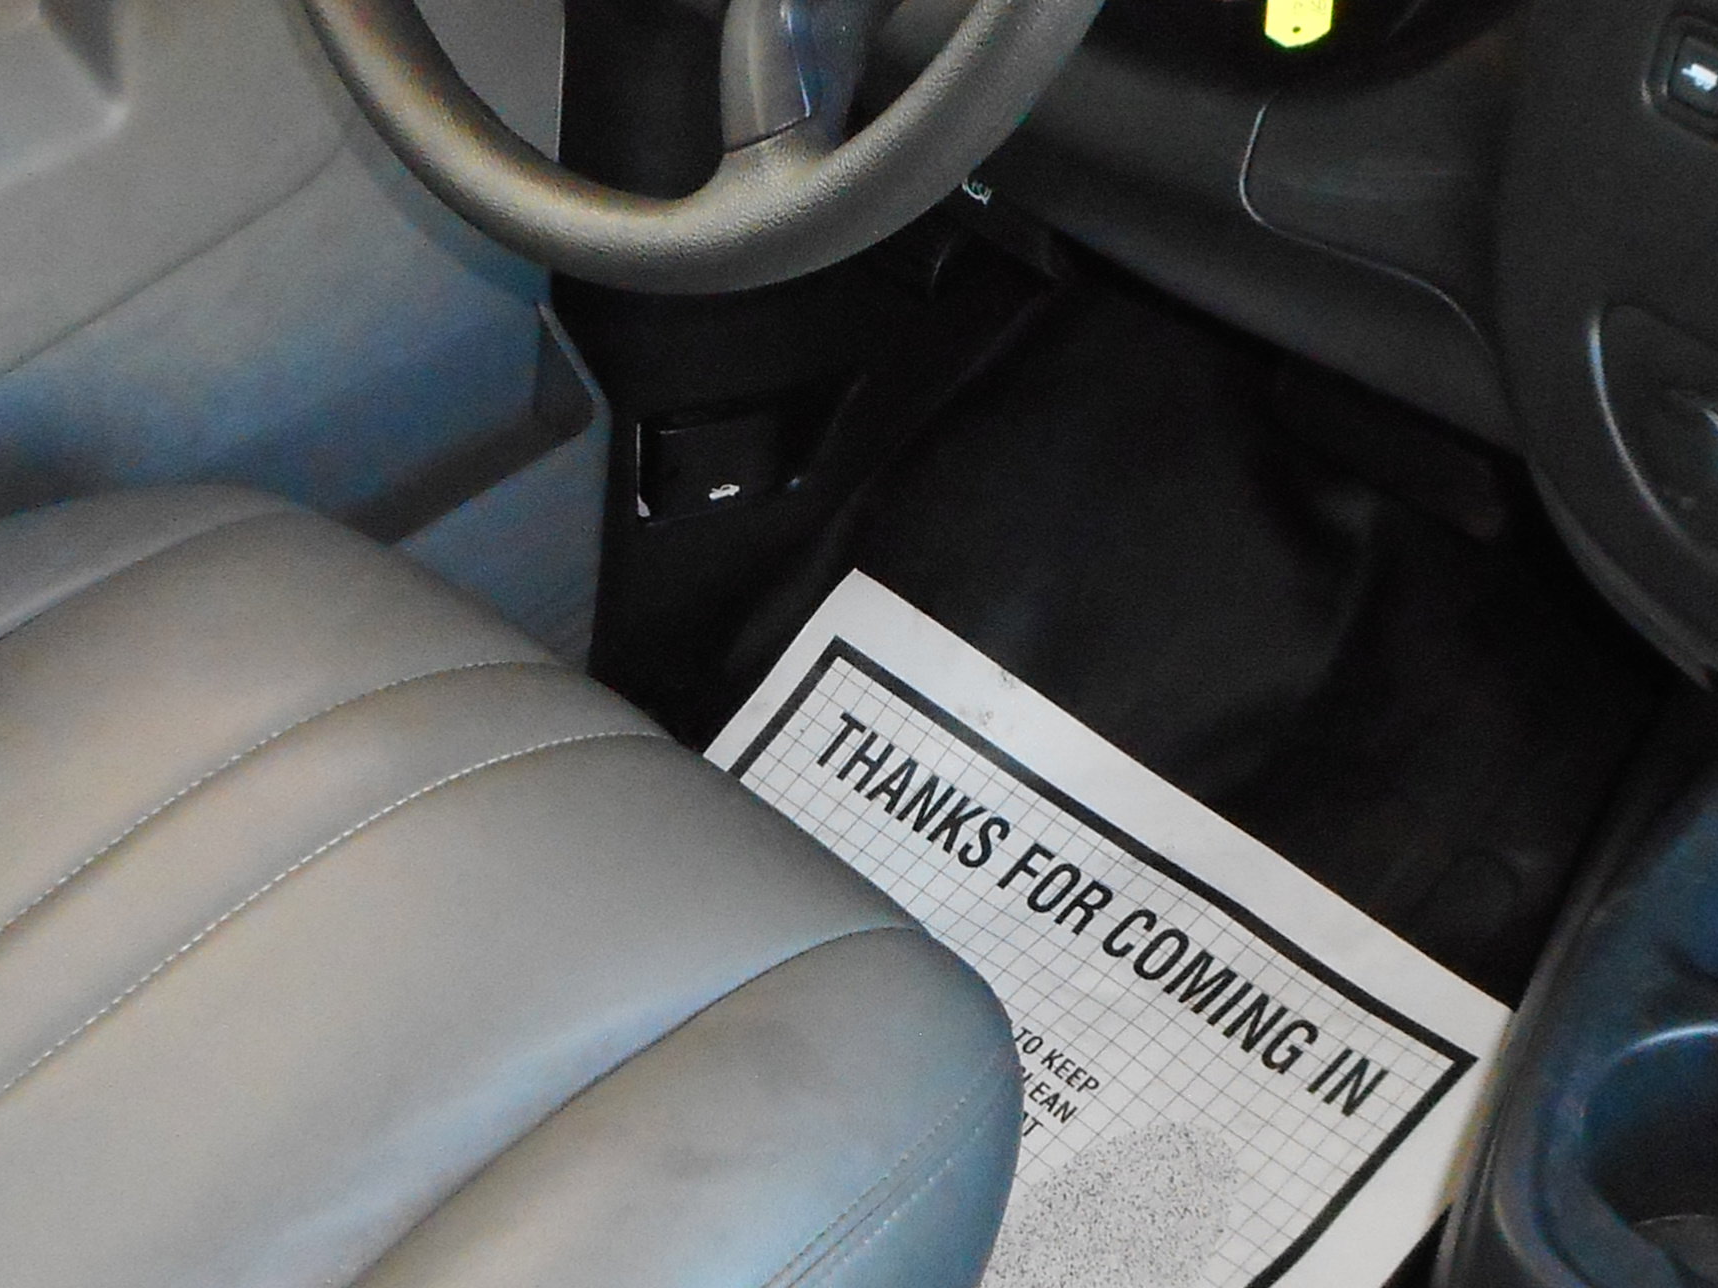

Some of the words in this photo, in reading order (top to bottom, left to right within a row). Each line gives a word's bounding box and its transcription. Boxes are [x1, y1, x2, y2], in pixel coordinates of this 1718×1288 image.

[817, 712, 1011, 868] THANKS
[996, 842, 1113, 935] FOR
[1102, 909, 1319, 1075] COMING
[1306, 1047, 1389, 1117] IN
[1014, 1026, 1044, 1055] TO
[1040, 1048, 1100, 1093] KEEP
